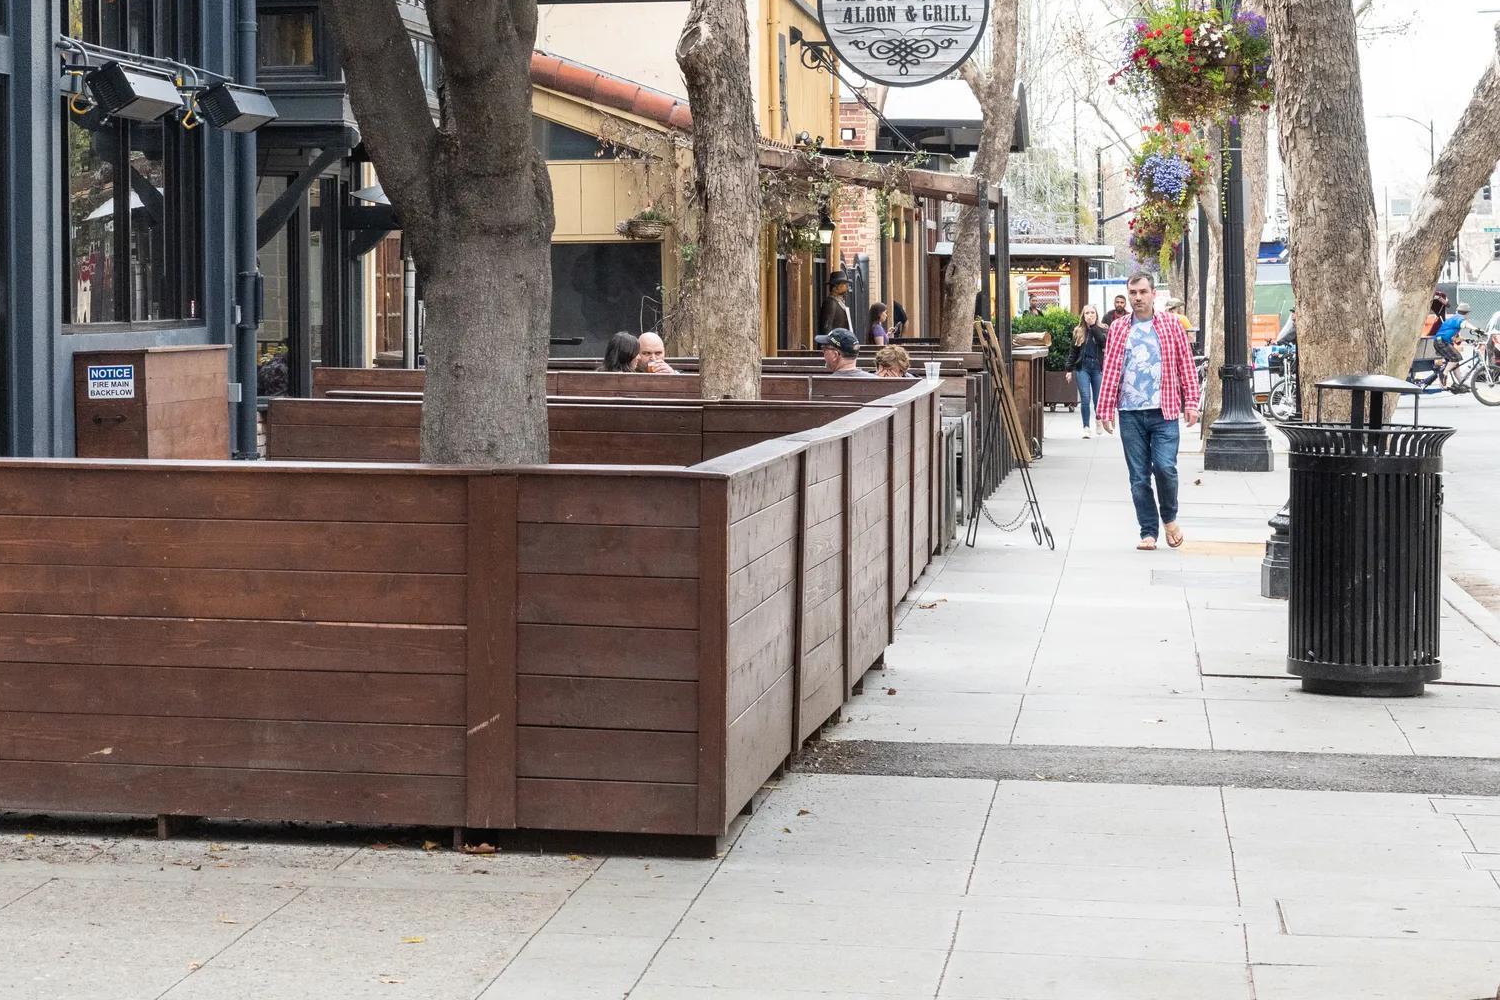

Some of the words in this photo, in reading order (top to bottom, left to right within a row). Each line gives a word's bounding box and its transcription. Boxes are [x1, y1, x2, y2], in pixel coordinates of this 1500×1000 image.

[905, 5, 917, 22] &
[923, 4, 972, 22] GRILL
[91, 368, 131, 378] NOTICE
